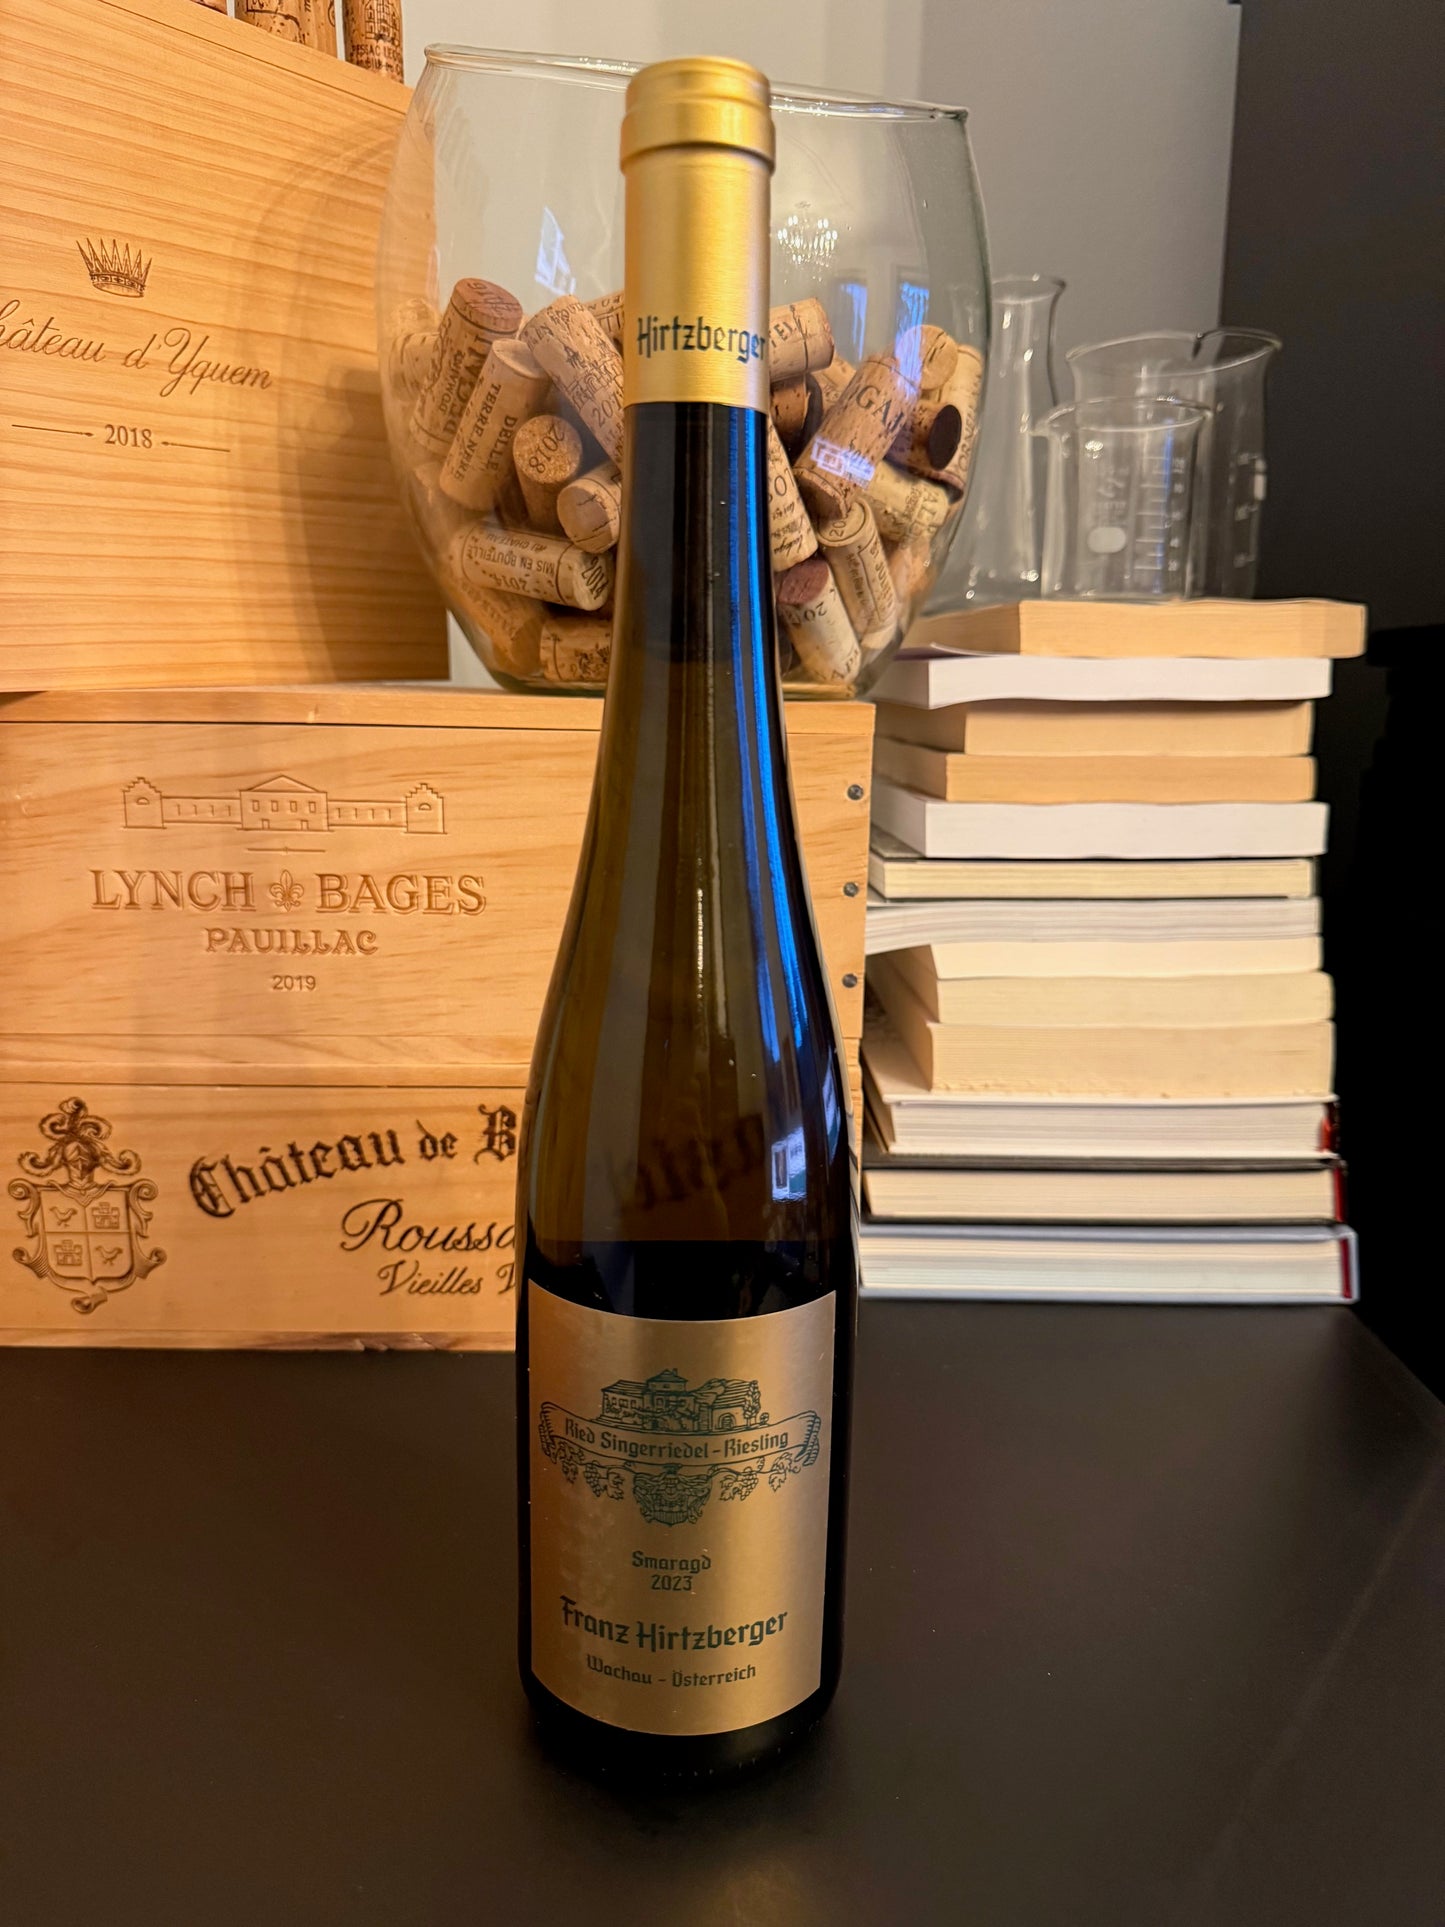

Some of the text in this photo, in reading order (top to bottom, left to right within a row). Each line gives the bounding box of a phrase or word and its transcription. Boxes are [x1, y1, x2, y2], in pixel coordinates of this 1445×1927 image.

[0, 299, 272, 398] hâteau d'Yquem
[637, 316, 765, 364] Hirtzberger
[590, 394, 624, 426] 201
[104, 424, 153, 449] 2018
[528, 423, 566, 475] 2018
[89, 869, 487, 916] LYNCH BAGES
[204, 927, 379, 956] PAUILLAC
[272, 975, 317, 991] 2019
[188, 1127, 406, 1218] Château
[415, 1118, 459, 1162] de
[377, 1260, 483, 1297] Vieilles
[564, 1418, 596, 1445] Ried
[600, 1431, 709, 1459] Singerriedel
[724, 1431, 789, 1459] Riesling
[631, 1550, 712, 1574] Smaragd
[651, 1574, 693, 1592] 2023
[559, 1594, 789, 1653] Franz Hirtzberger
[586, 1653, 653, 1685] Wachau
[671, 1664, 757, 1688] Österreich
